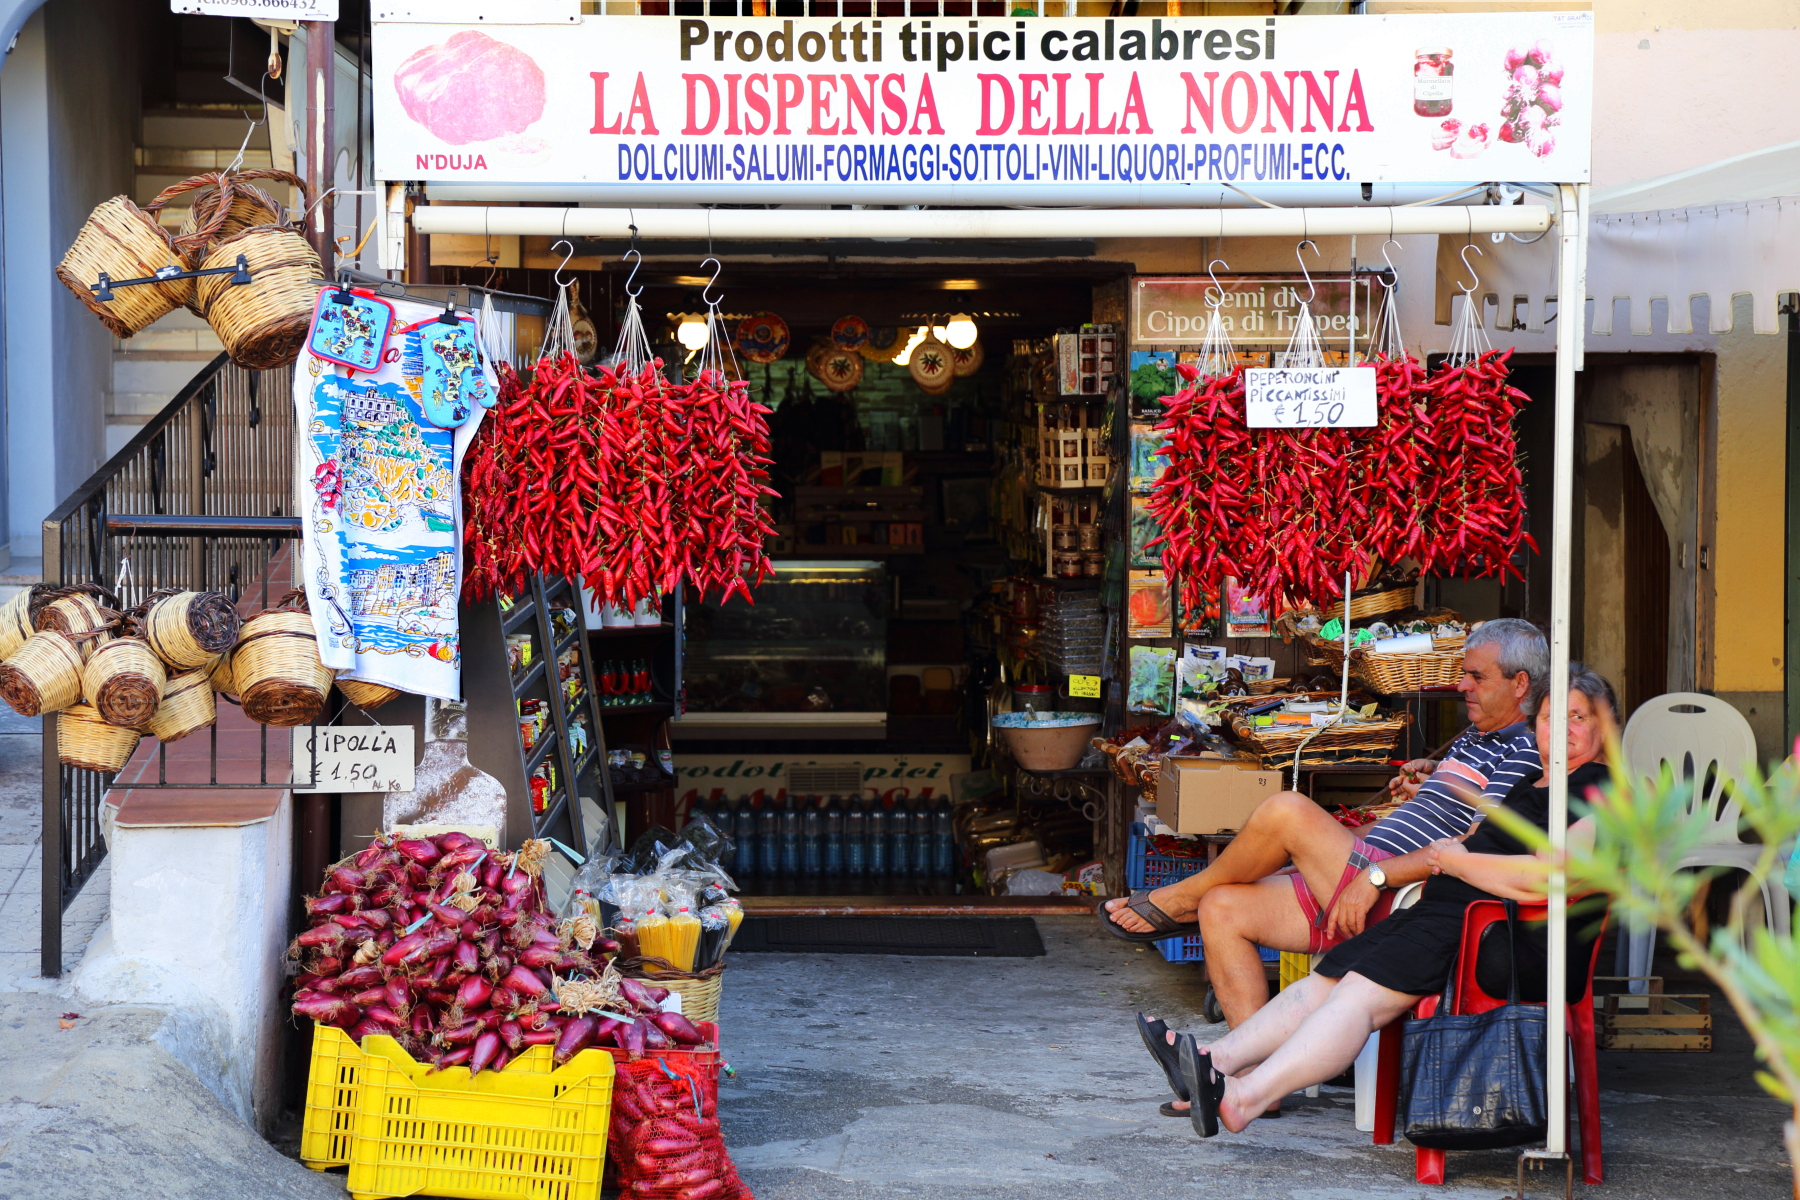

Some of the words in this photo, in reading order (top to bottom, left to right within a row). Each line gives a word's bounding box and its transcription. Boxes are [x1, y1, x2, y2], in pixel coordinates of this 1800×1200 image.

[680, 19, 882, 62] Prodotti
[899, 20, 1026, 72] tipici
[1040, 18, 1276, 62] calabresi
[589, 71, 660, 136] LA
[681, 72, 945, 136] DISPENSA
[976, 71, 1154, 136] DELLA
[1180, 68, 1374, 135] NONNA
[416, 153, 488, 171] N'DUJA
[1203, 286, 1265, 308] Semi
[1273, 286, 1297, 308] di
[1241, 310, 1264, 331] di
[1269, 310, 1360, 337] Trpea
[1250, 387, 1346, 403] PICCANTISSIMI
[1272, 403, 1285, 424] €
[1293, 402, 1345, 427] 1,50
[306, 734, 396, 753] CIPOLLA
[1258, 777, 1267, 787] 23
